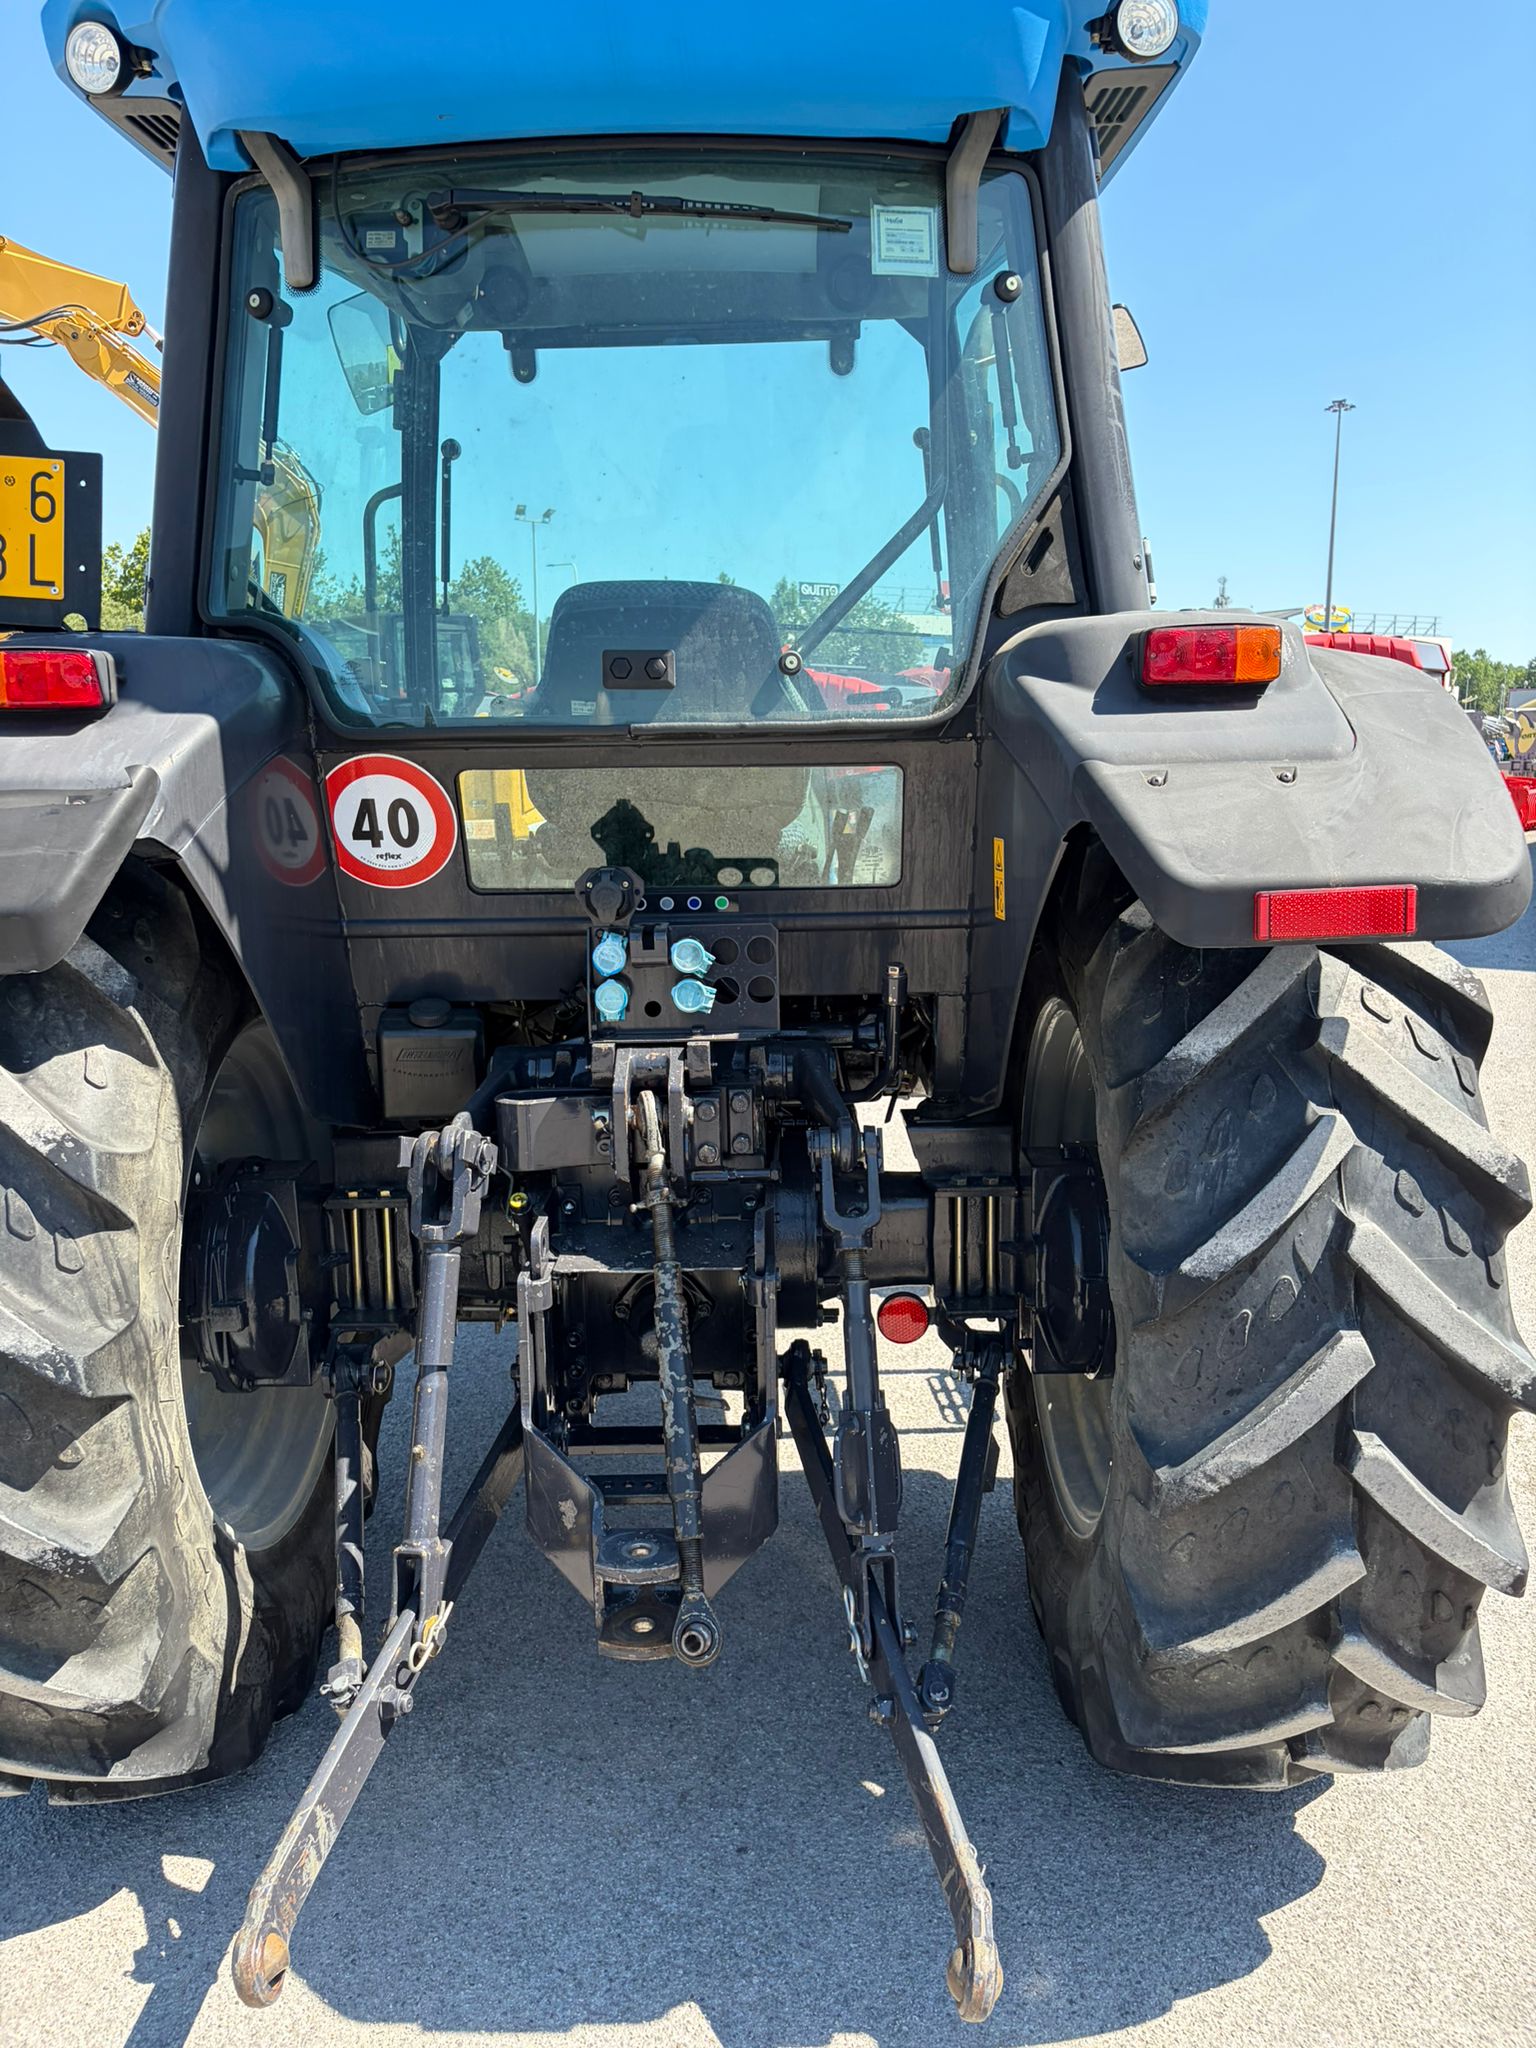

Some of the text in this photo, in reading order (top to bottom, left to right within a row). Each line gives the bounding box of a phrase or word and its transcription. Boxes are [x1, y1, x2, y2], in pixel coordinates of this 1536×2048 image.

[30, 471, 56, 523] 6
[351, 797, 420, 849] 40
[376, 852, 402, 861] reflex
